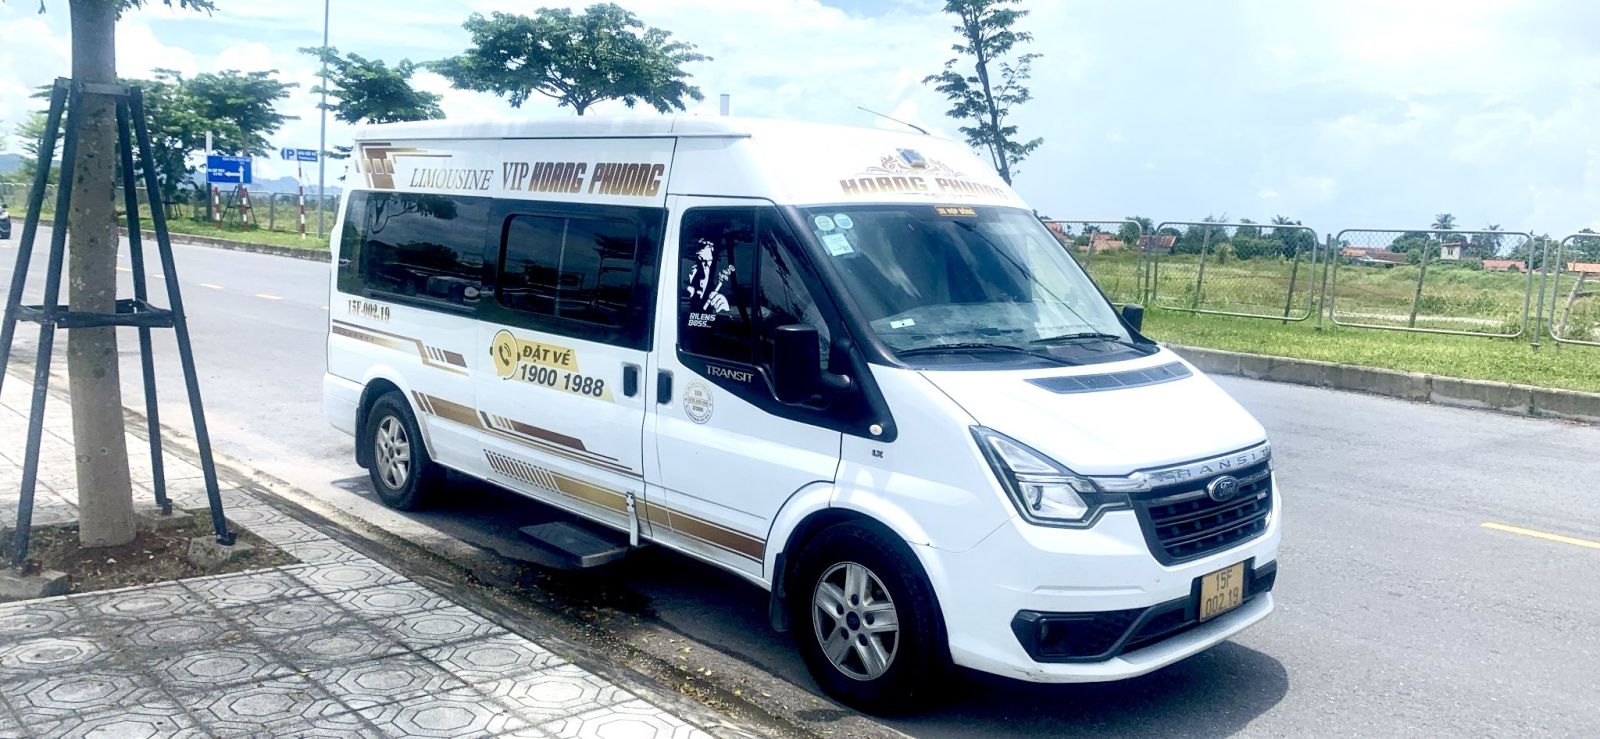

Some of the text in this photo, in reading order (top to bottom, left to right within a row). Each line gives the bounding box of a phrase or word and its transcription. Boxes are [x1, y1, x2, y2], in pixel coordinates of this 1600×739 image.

[409, 161, 665, 197] LIMOUSINE VIP HOANG PHUONG
[839, 176, 928, 195] HOANG
[522, 344, 571, 366] ĐẶT VÉ
[520, 363, 605, 397] 1900 1988
[705, 364, 754, 383] TRANSIT
[1215, 569, 1233, 591] 15F
[1206, 586, 1239, 615] 002.19
